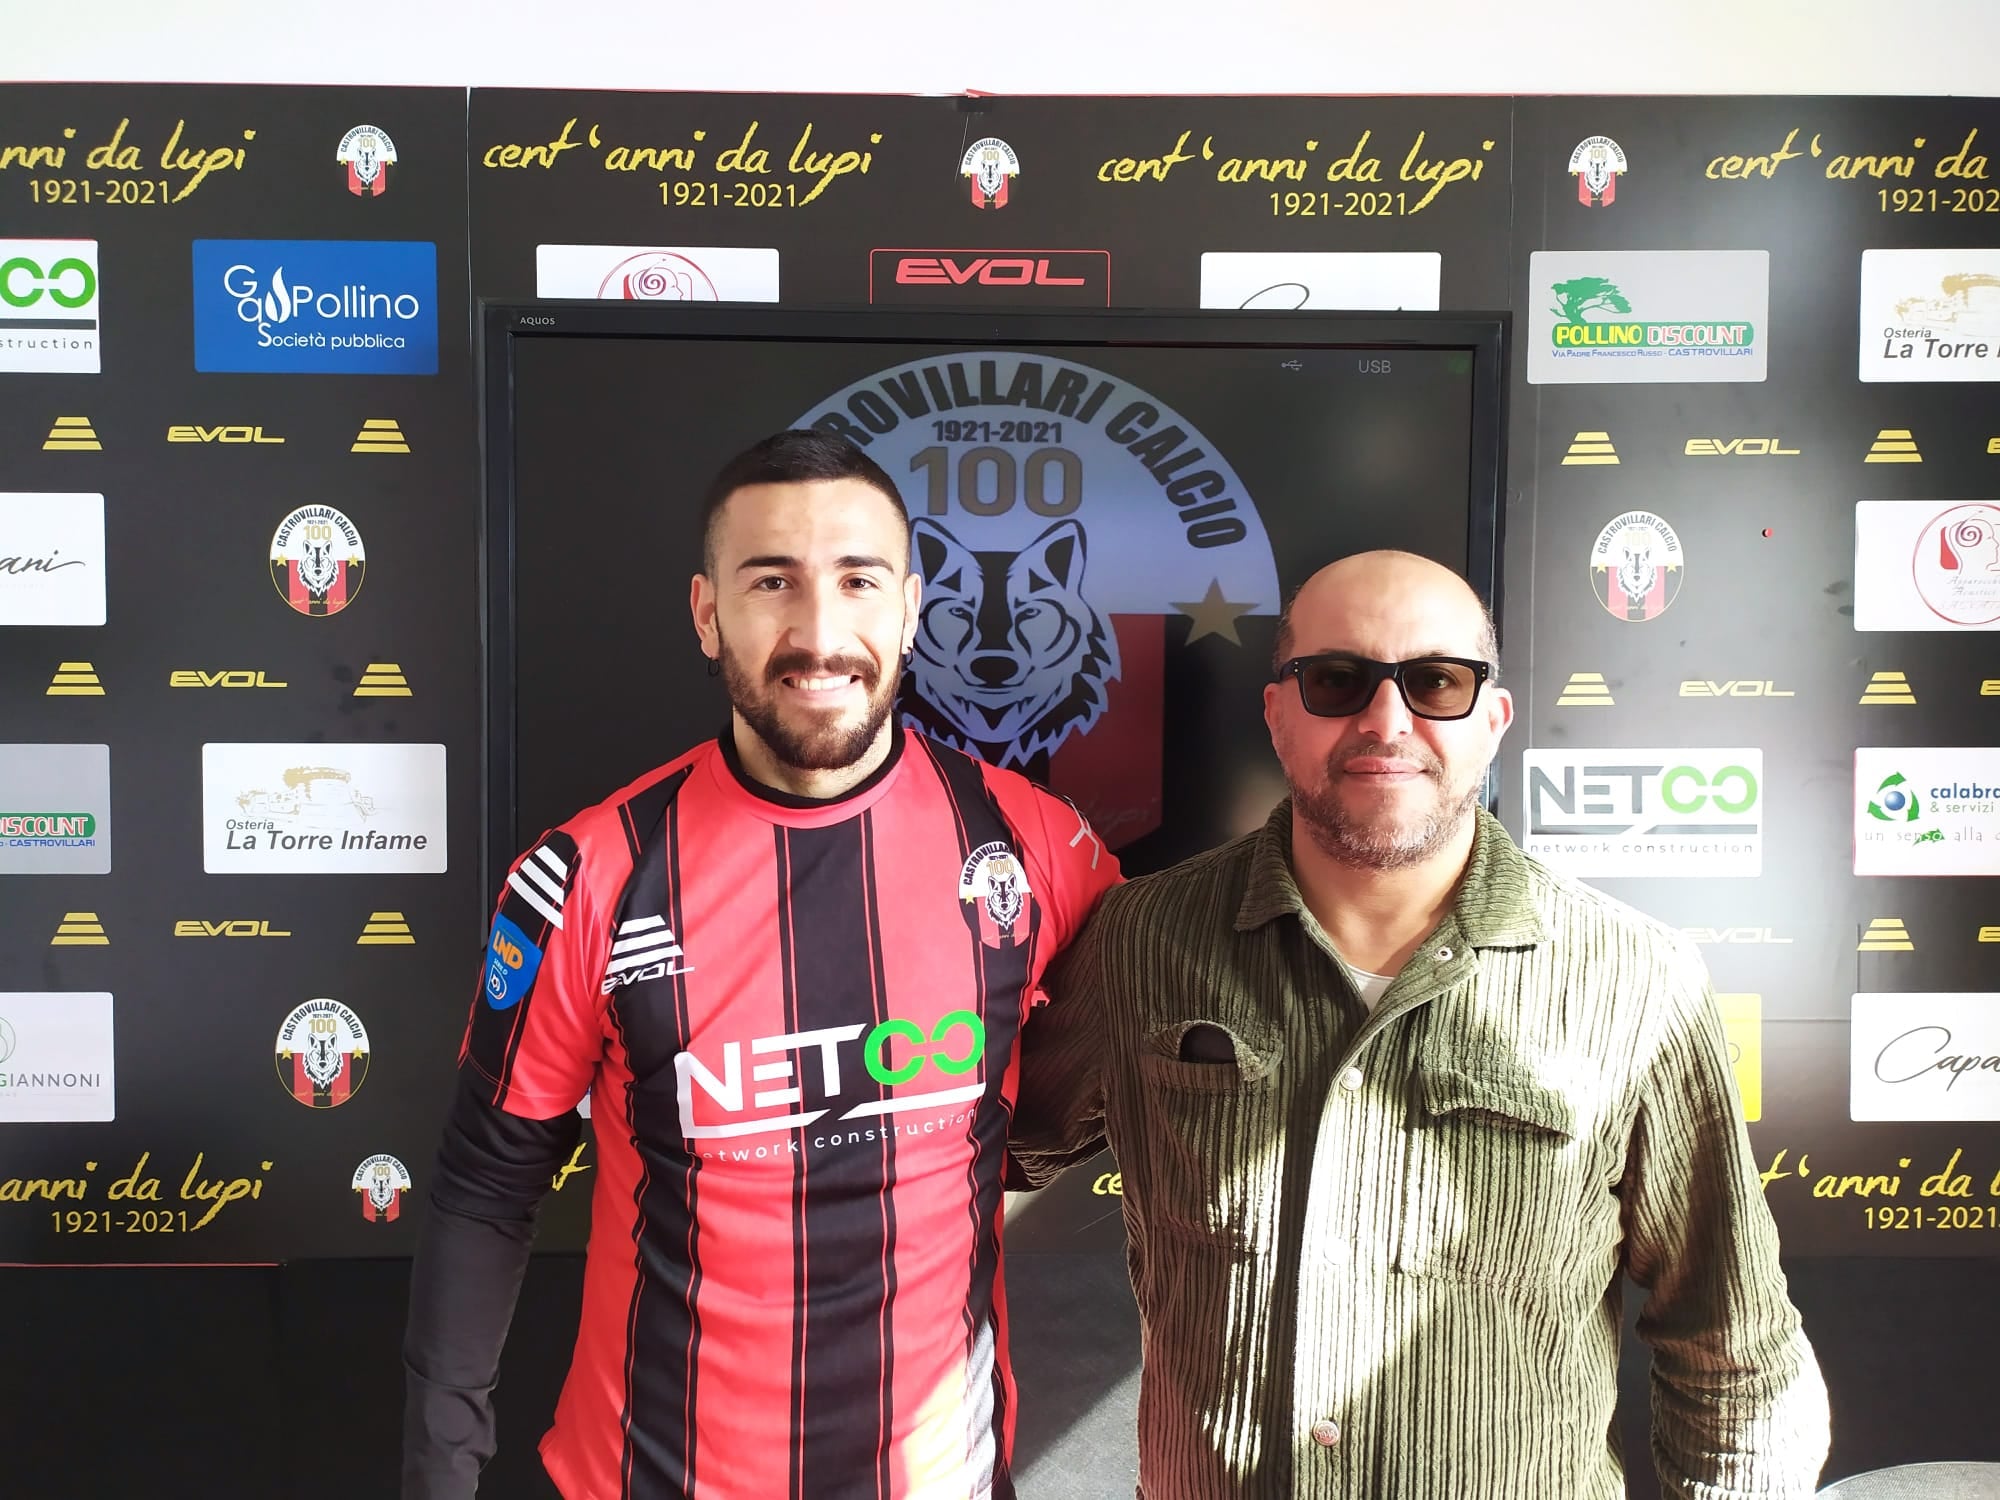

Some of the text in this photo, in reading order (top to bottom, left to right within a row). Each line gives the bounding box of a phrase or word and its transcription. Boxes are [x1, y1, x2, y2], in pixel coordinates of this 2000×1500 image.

[86, 118, 141, 170] da
[161, 119, 256, 203] lupi
[716, 121, 771, 174] da
[788, 123, 883, 207] lupi
[1934, 128, 1989, 180] da
[1326, 130, 1383, 184] da
[1400, 130, 1495, 215] lupi
[30, 179, 169, 204] 1921-2021
[658, 182, 797, 208] 1921-2021
[1269, 192, 1407, 216] 1921-2021
[895, 258, 1086, 286] EVOL
[293, 285, 420, 319] Pollino
[520, 316, 555, 325] AQUOS
[258, 322, 405, 349] Società pubblica
[1556, 325, 1747, 345] POLLINO DISCOUNT
[1883, 327, 1932, 338] Osteria
[1668, 348, 1753, 356] CASTROVILLARI
[1883, 339, 1914, 359] La
[1925, 339, 1989, 359] Torre
[1358, 359, 1392, 374] USB
[167, 426, 285, 443] EVOL
[931, 419, 1062, 444] 1921-2021
[811, 360, 1248, 549] ROVILLARI CALCIO
[1684, 438, 1800, 455] EVOL
[909, 446, 1083, 517] 100
[277, 508, 358, 547] CASTROVILLARI CALCIO
[304, 525, 332, 540] 100
[1598, 514, 1677, 554] CASTROVILLARI CALCIO
[169, 671, 288, 687] EVOL
[1679, 680, 1795, 697] EVOL
[1930, 801, 1994, 813] & servizi
[0, 816, 88, 836] ISCOUNT
[226, 819, 275, 831] Osteria
[1865, 832, 1884, 841] un
[1954, 826, 1983, 842] alla
[9, 839, 95, 847] CASTROVILLARI
[226, 830, 427, 851] La Torre Infame
[1530, 842, 1753, 853] network construction
[986, 859, 1014, 875] 100
[174, 920, 291, 937] EVOL
[493, 930, 523, 970] LND
[601, 961, 695, 995] EVOL
[283, 1002, 363, 1041] CASTROVILLARI CALCIO
[309, 1019, 336, 1033] 100
[701, 1107, 976, 1162] twork construction
[1919, 1148, 1974, 1198] da
[107, 1151, 162, 1201] da
[180, 1152, 274, 1231] lupi
[51, 1211, 190, 1234] 1921-2021
[1864, 1206, 1996, 1229] 1921-2021
